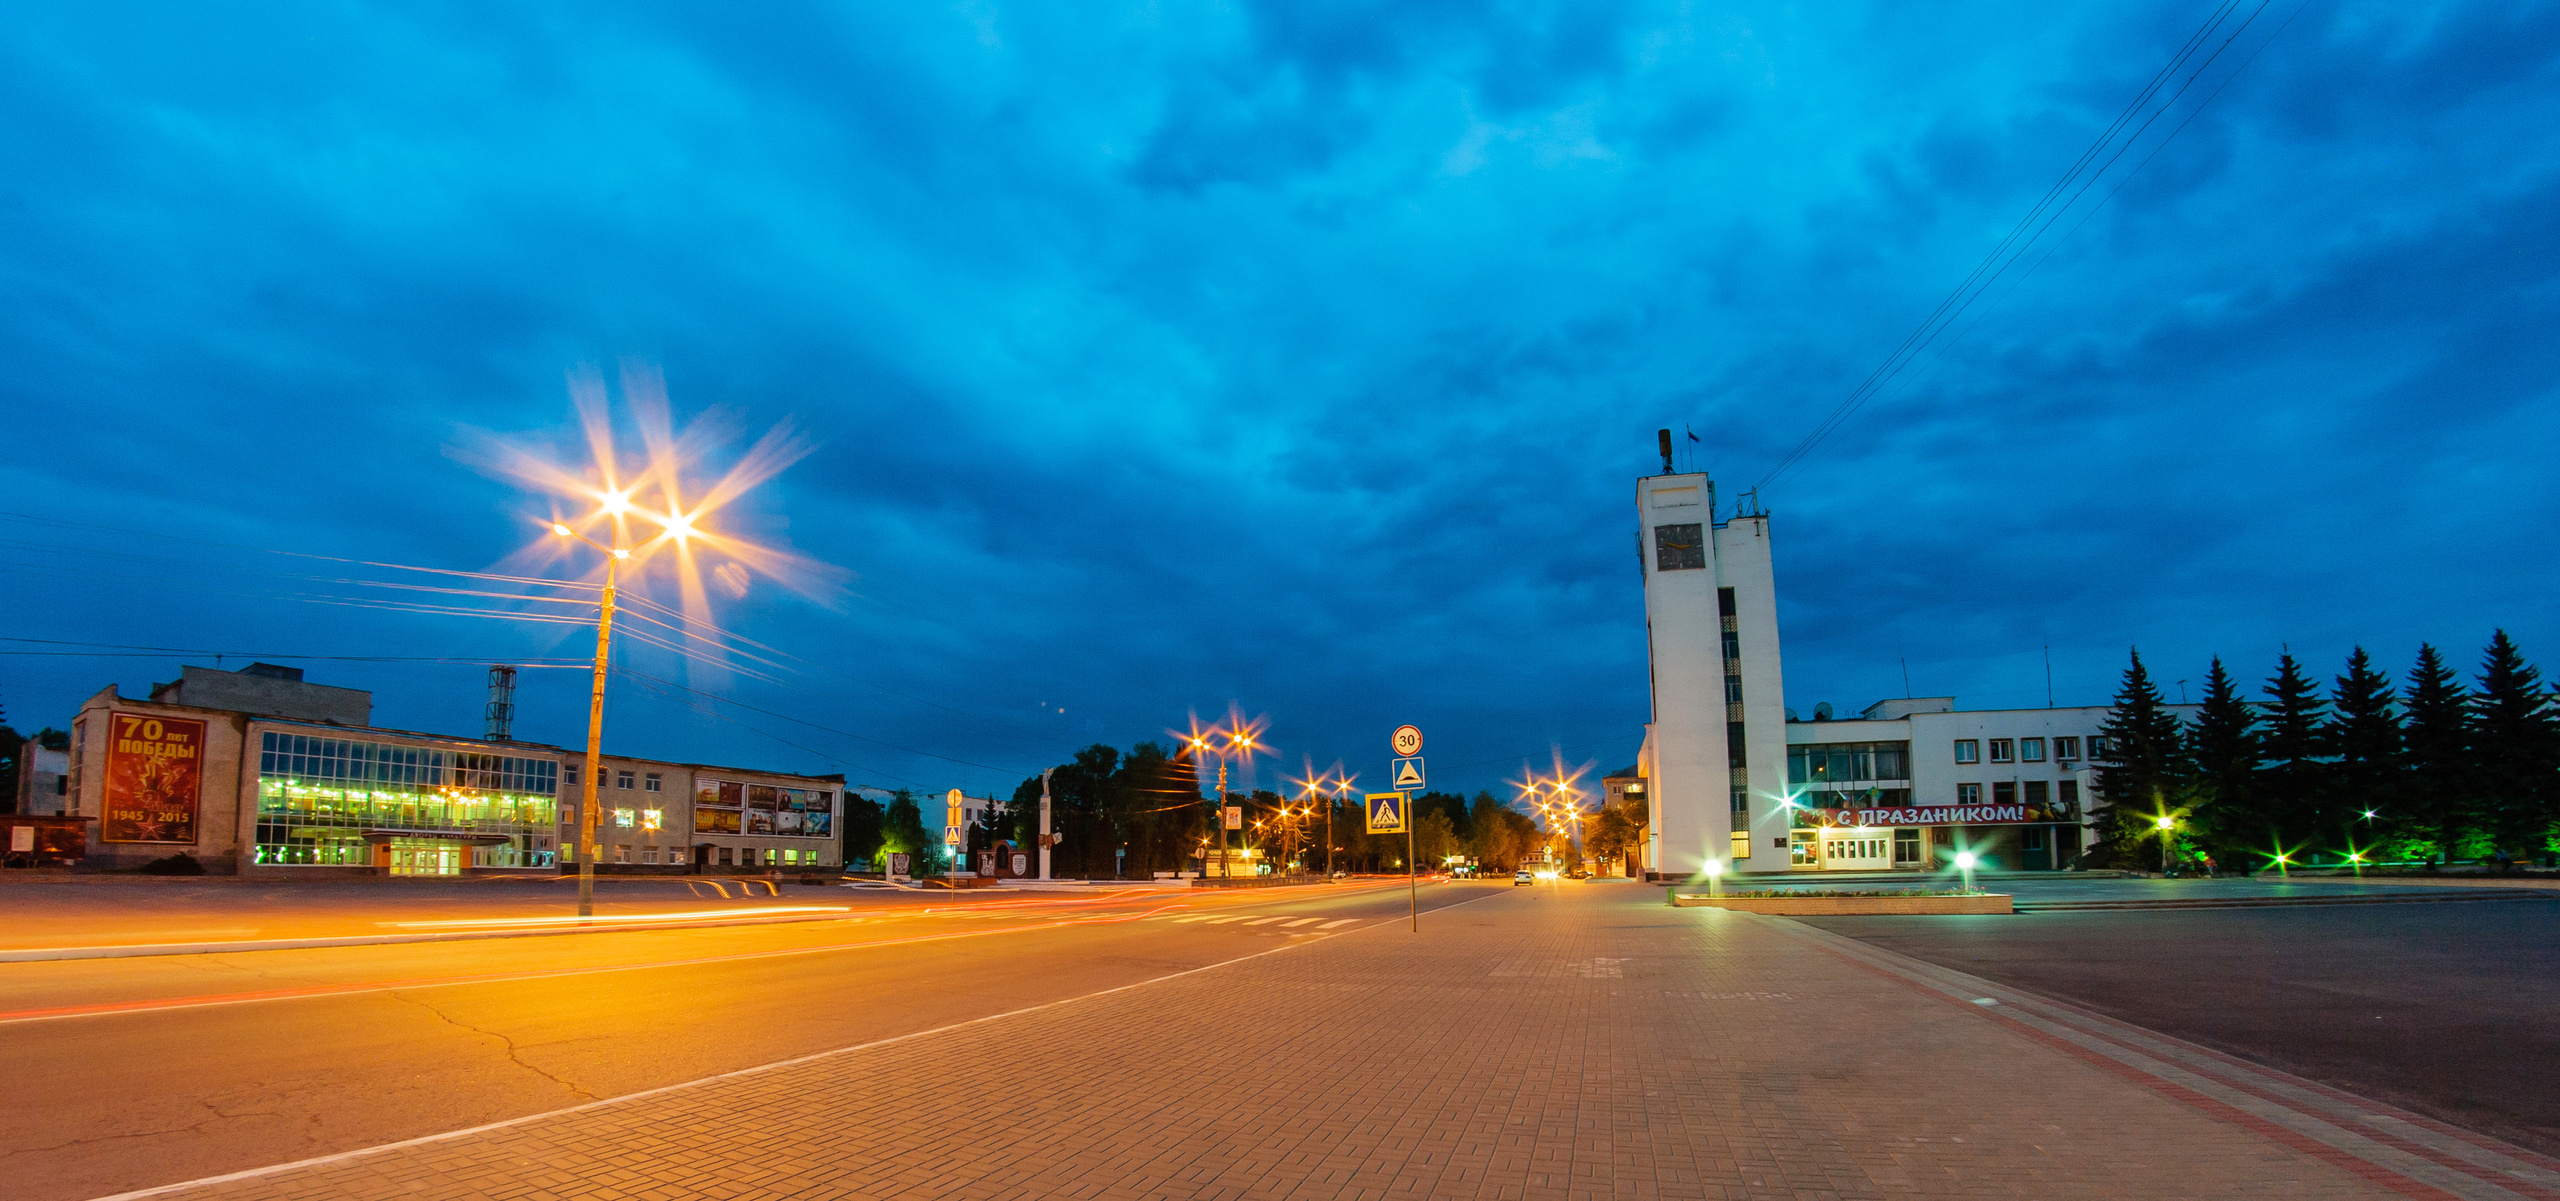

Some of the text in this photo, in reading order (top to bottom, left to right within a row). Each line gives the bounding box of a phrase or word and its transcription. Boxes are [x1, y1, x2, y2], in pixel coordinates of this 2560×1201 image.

[121, 717, 163, 740] 70
[119, 739, 195, 758] ПОБЕДЫ
[1399, 734, 1415, 747] 30
[112, 810, 189, 822] 1945 2015
[1837, 805, 2024, 825] С ПРАЗДНИКОМ!
